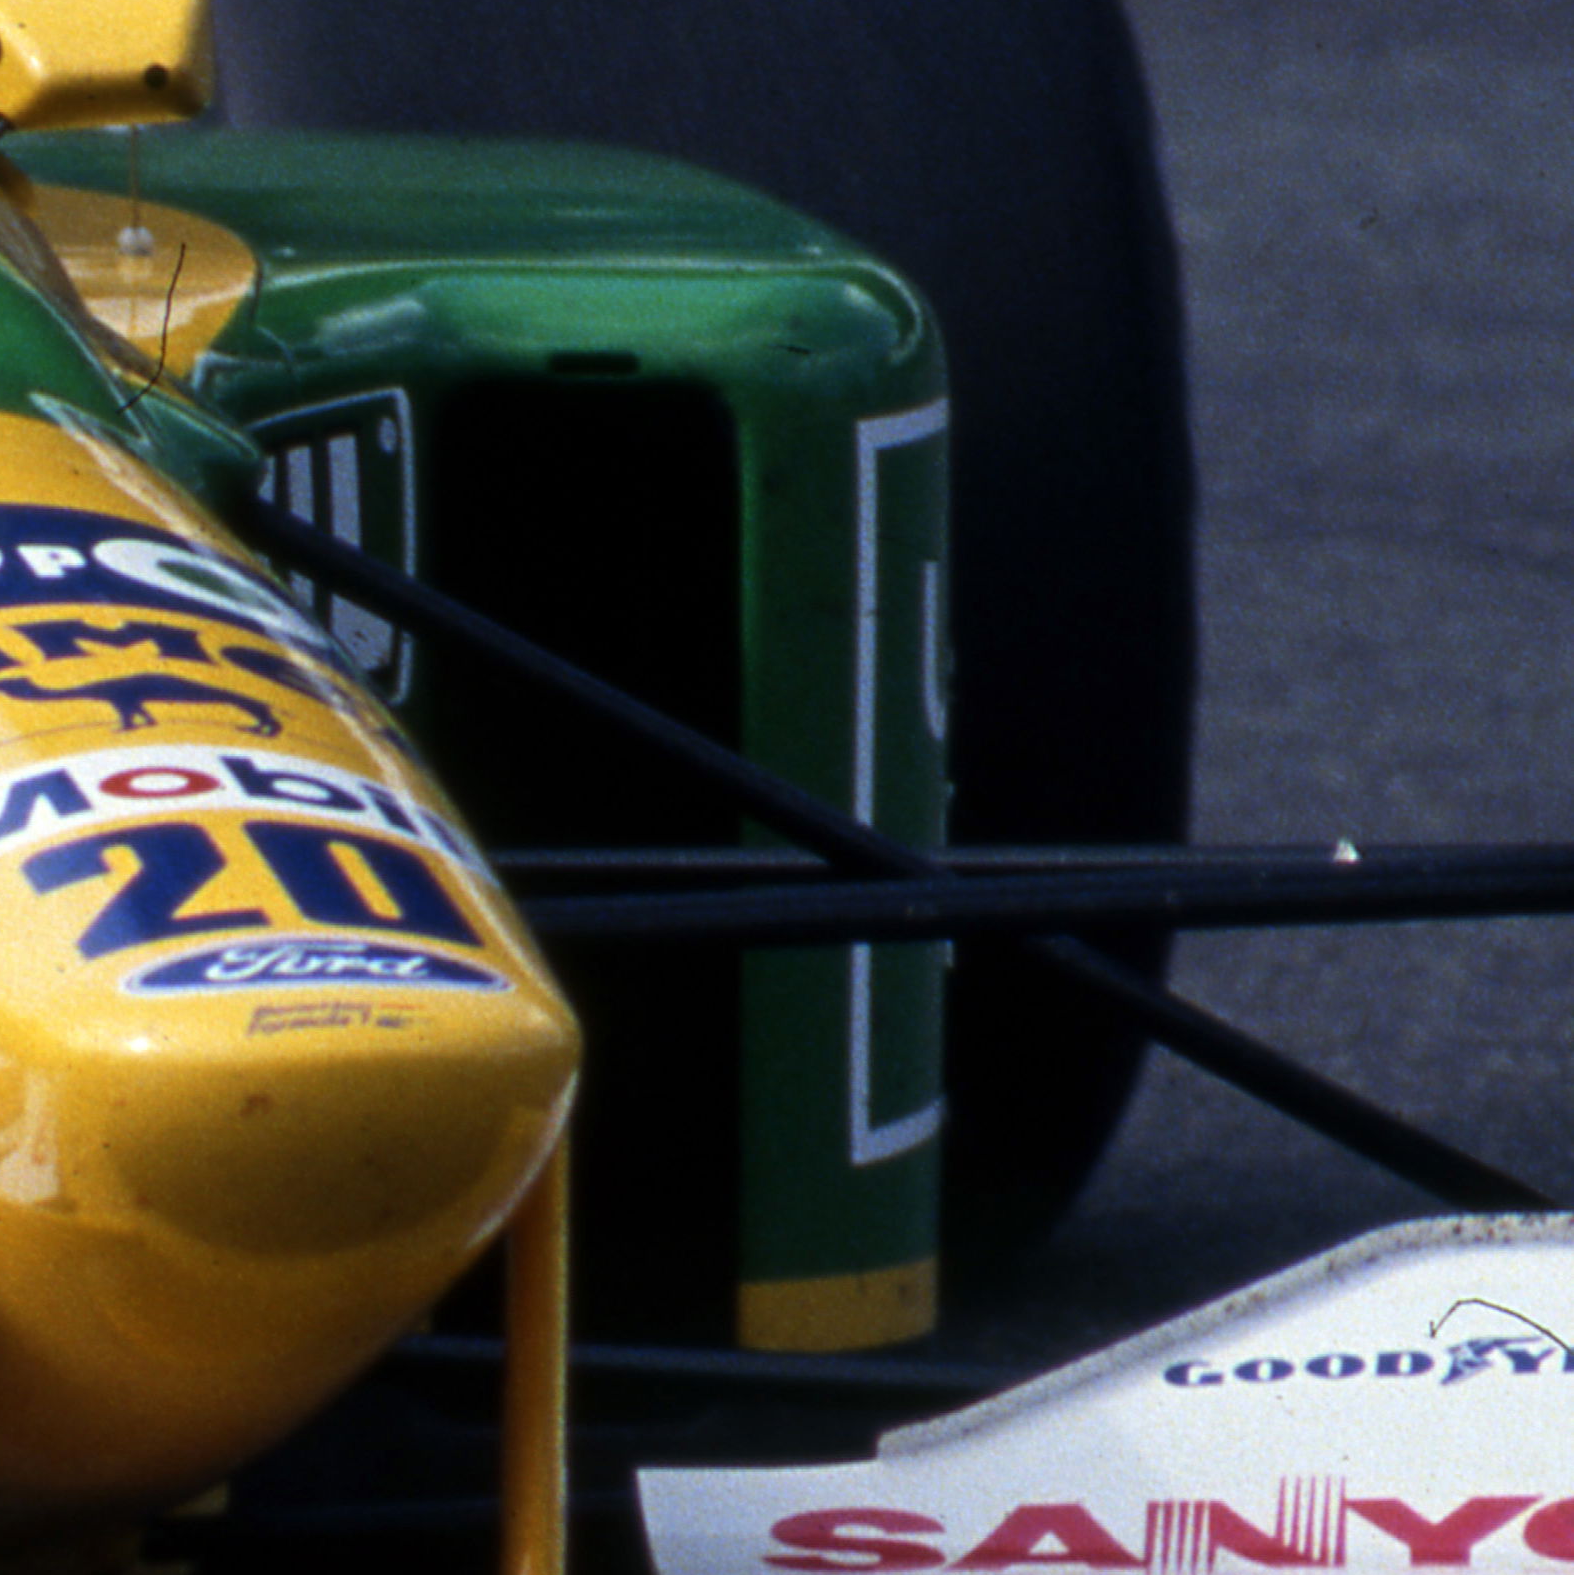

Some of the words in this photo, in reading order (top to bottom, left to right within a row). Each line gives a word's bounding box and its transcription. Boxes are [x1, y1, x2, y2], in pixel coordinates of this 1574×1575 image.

[21, 821, 485, 962] 20
[205, 934, 429, 982] Ford
[1162, 1340, 1574, 1387] GOODY
[762, 1476, 1574, 1575] SANY
